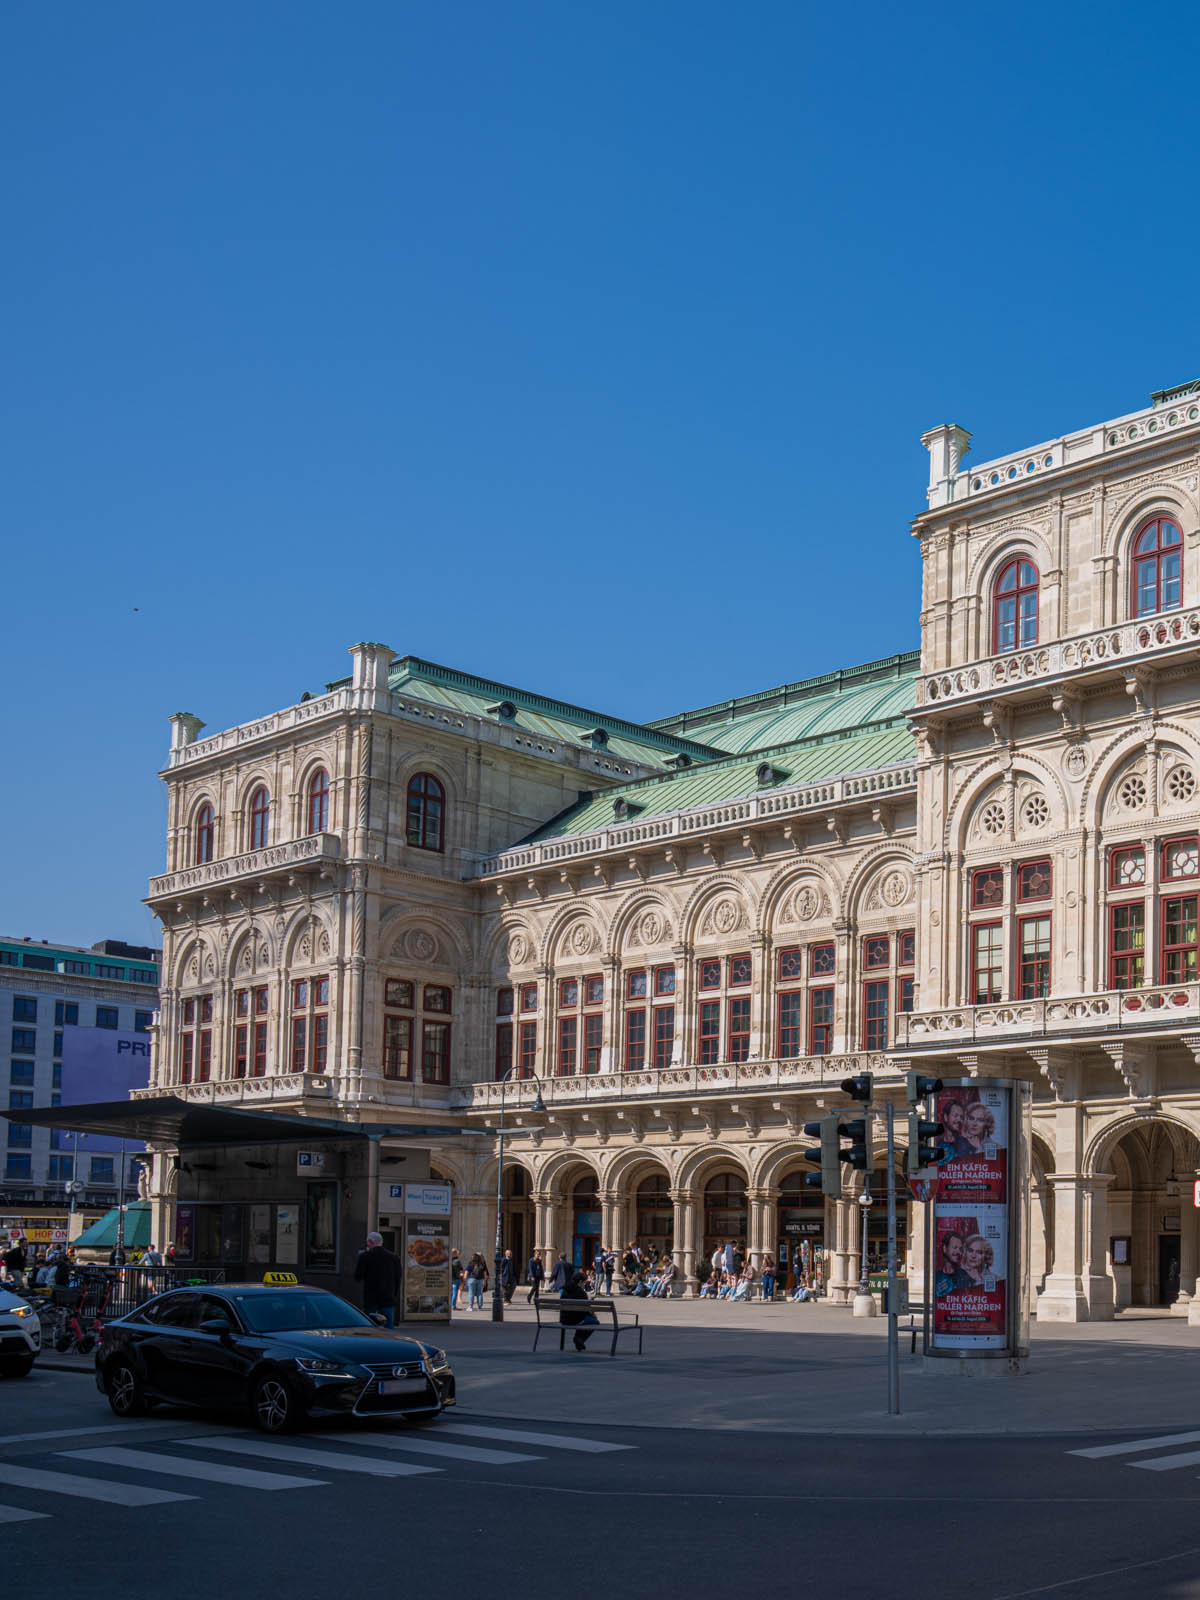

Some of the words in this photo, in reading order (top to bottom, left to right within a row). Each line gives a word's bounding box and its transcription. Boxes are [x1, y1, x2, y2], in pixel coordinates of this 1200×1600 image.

[965, 1172, 1002, 1180] NARREN
[271, 1273, 294, 1281] TAXI
[964, 1303, 1001, 1311] NARREN
